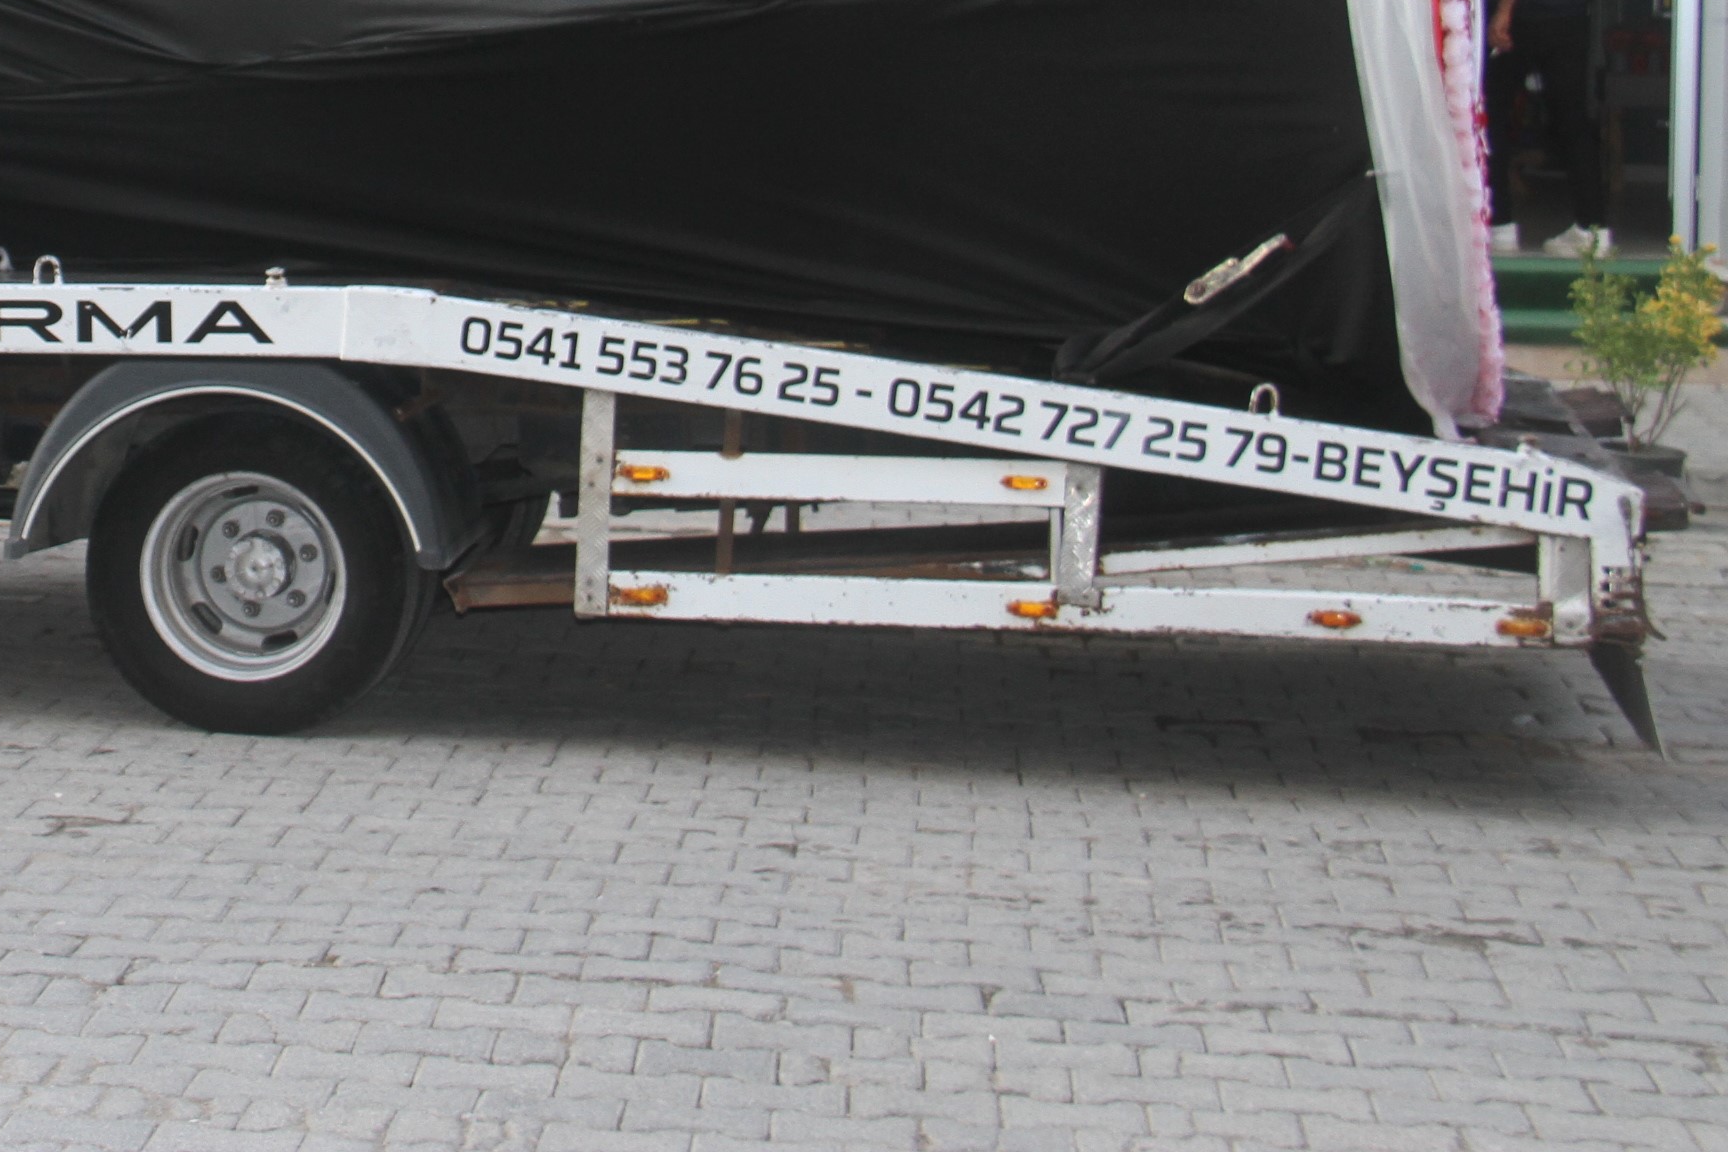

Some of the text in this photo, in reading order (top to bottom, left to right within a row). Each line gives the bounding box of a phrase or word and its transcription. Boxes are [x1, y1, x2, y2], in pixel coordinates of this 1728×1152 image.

[461, 316, 581, 370] 0541
[596, 336, 689, 385] 553
[705, 351, 763, 396] 76
[777, 362, 841, 407] 25
[888, 377, 1026, 435] 0542
[1041, 400, 1131, 449] 727
[1148, 415, 1207, 462] 25
